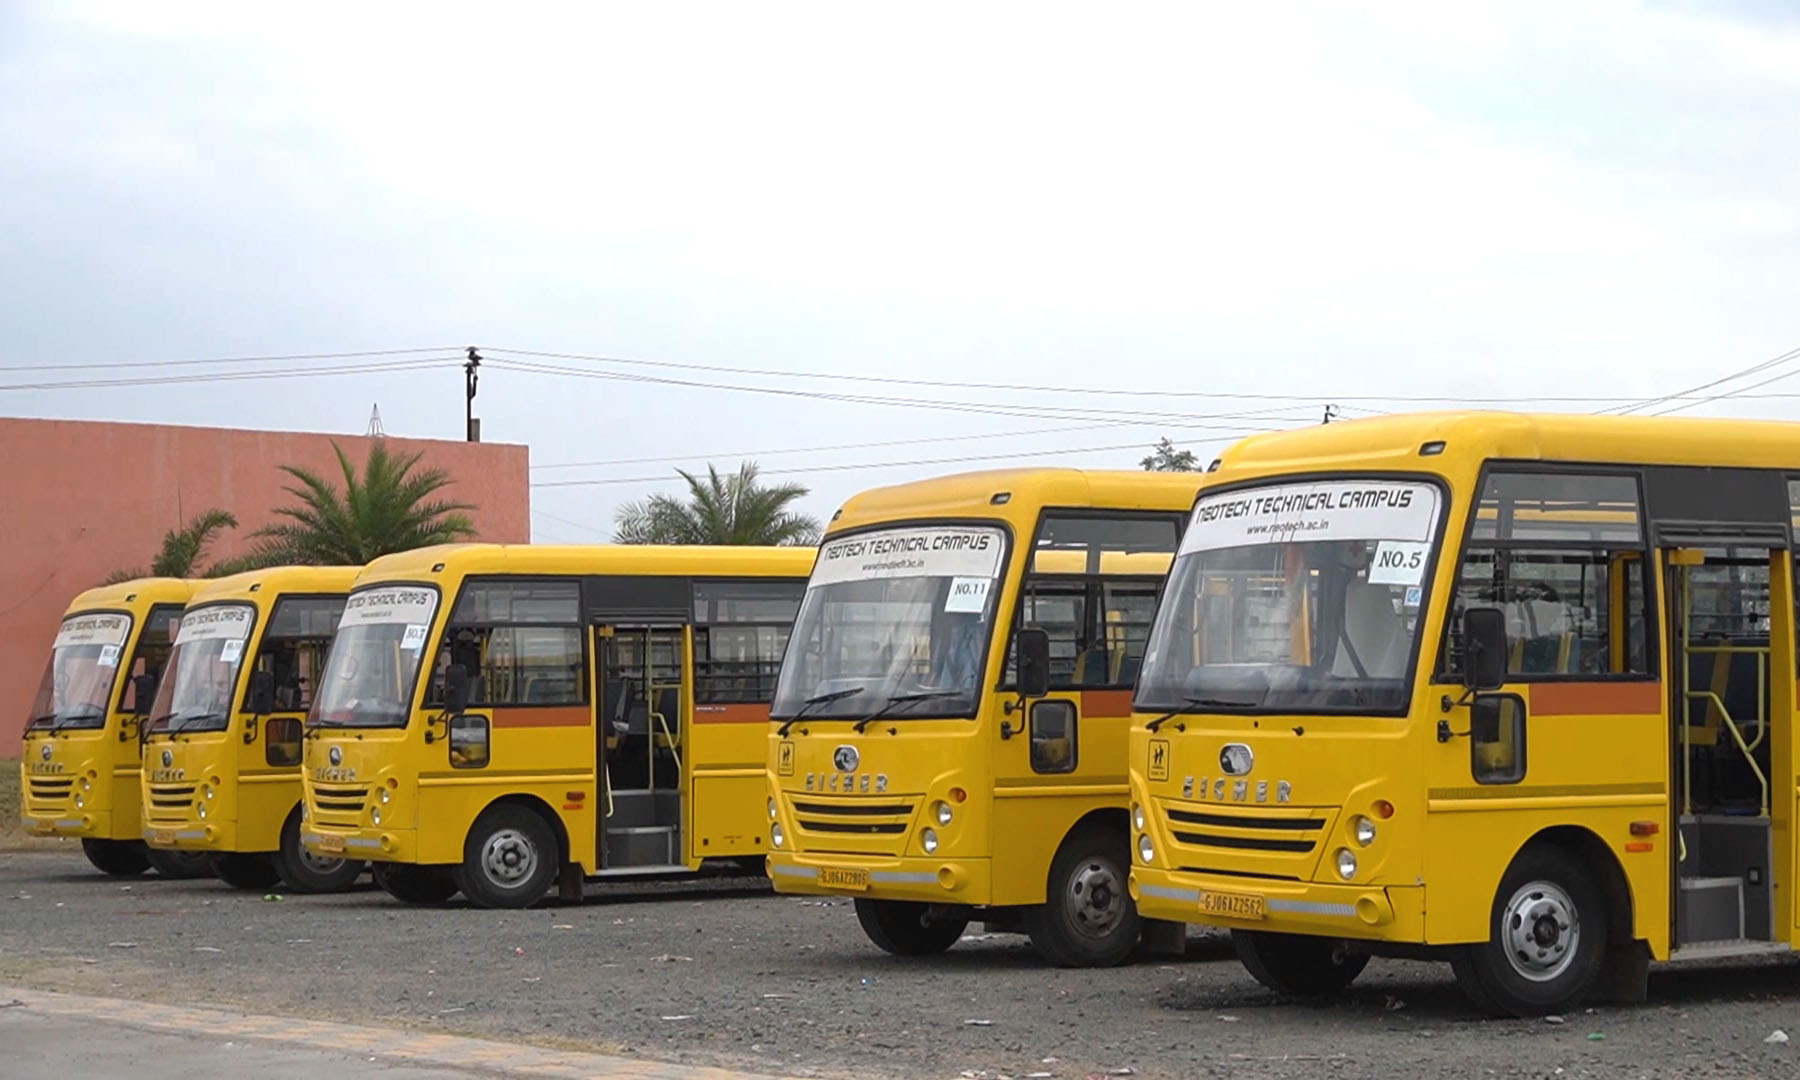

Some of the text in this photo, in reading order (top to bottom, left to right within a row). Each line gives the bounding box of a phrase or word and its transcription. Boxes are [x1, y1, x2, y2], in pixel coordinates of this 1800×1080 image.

[1196, 489, 1413, 524] NEOTECH TECHNICAL CAMPUS
[1246, 519, 1329, 535] www.neotech.ac.in
[869, 536, 929, 555] TECHNICAL
[932, 535, 990, 551] CAMPUS
[1378, 551, 1421, 569] NO.5
[806, 772, 888, 793] EICHER
[1182, 776, 1292, 803] EICHER
